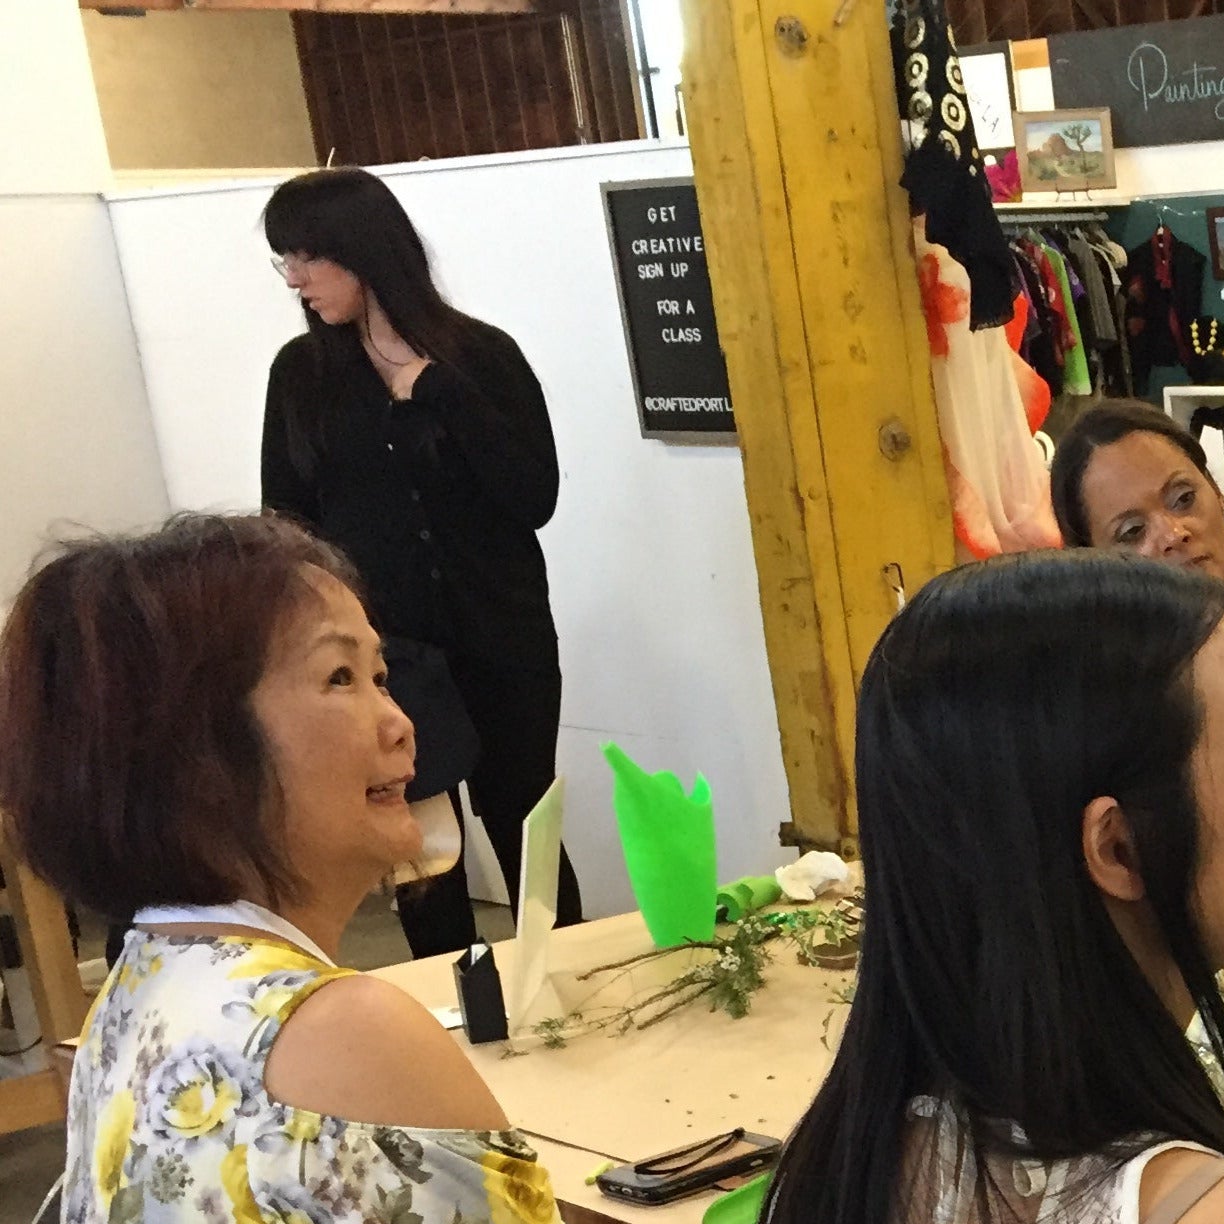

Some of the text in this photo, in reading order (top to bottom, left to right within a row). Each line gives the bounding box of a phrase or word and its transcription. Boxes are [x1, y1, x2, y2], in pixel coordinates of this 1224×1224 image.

[647, 205, 676, 224] GET
[631, 236, 703, 255] CREATIVE
[637, 262, 689, 279] SIGN UP
[656, 299, 695, 315] FOR A
[661, 327, 702, 343] CLASS
